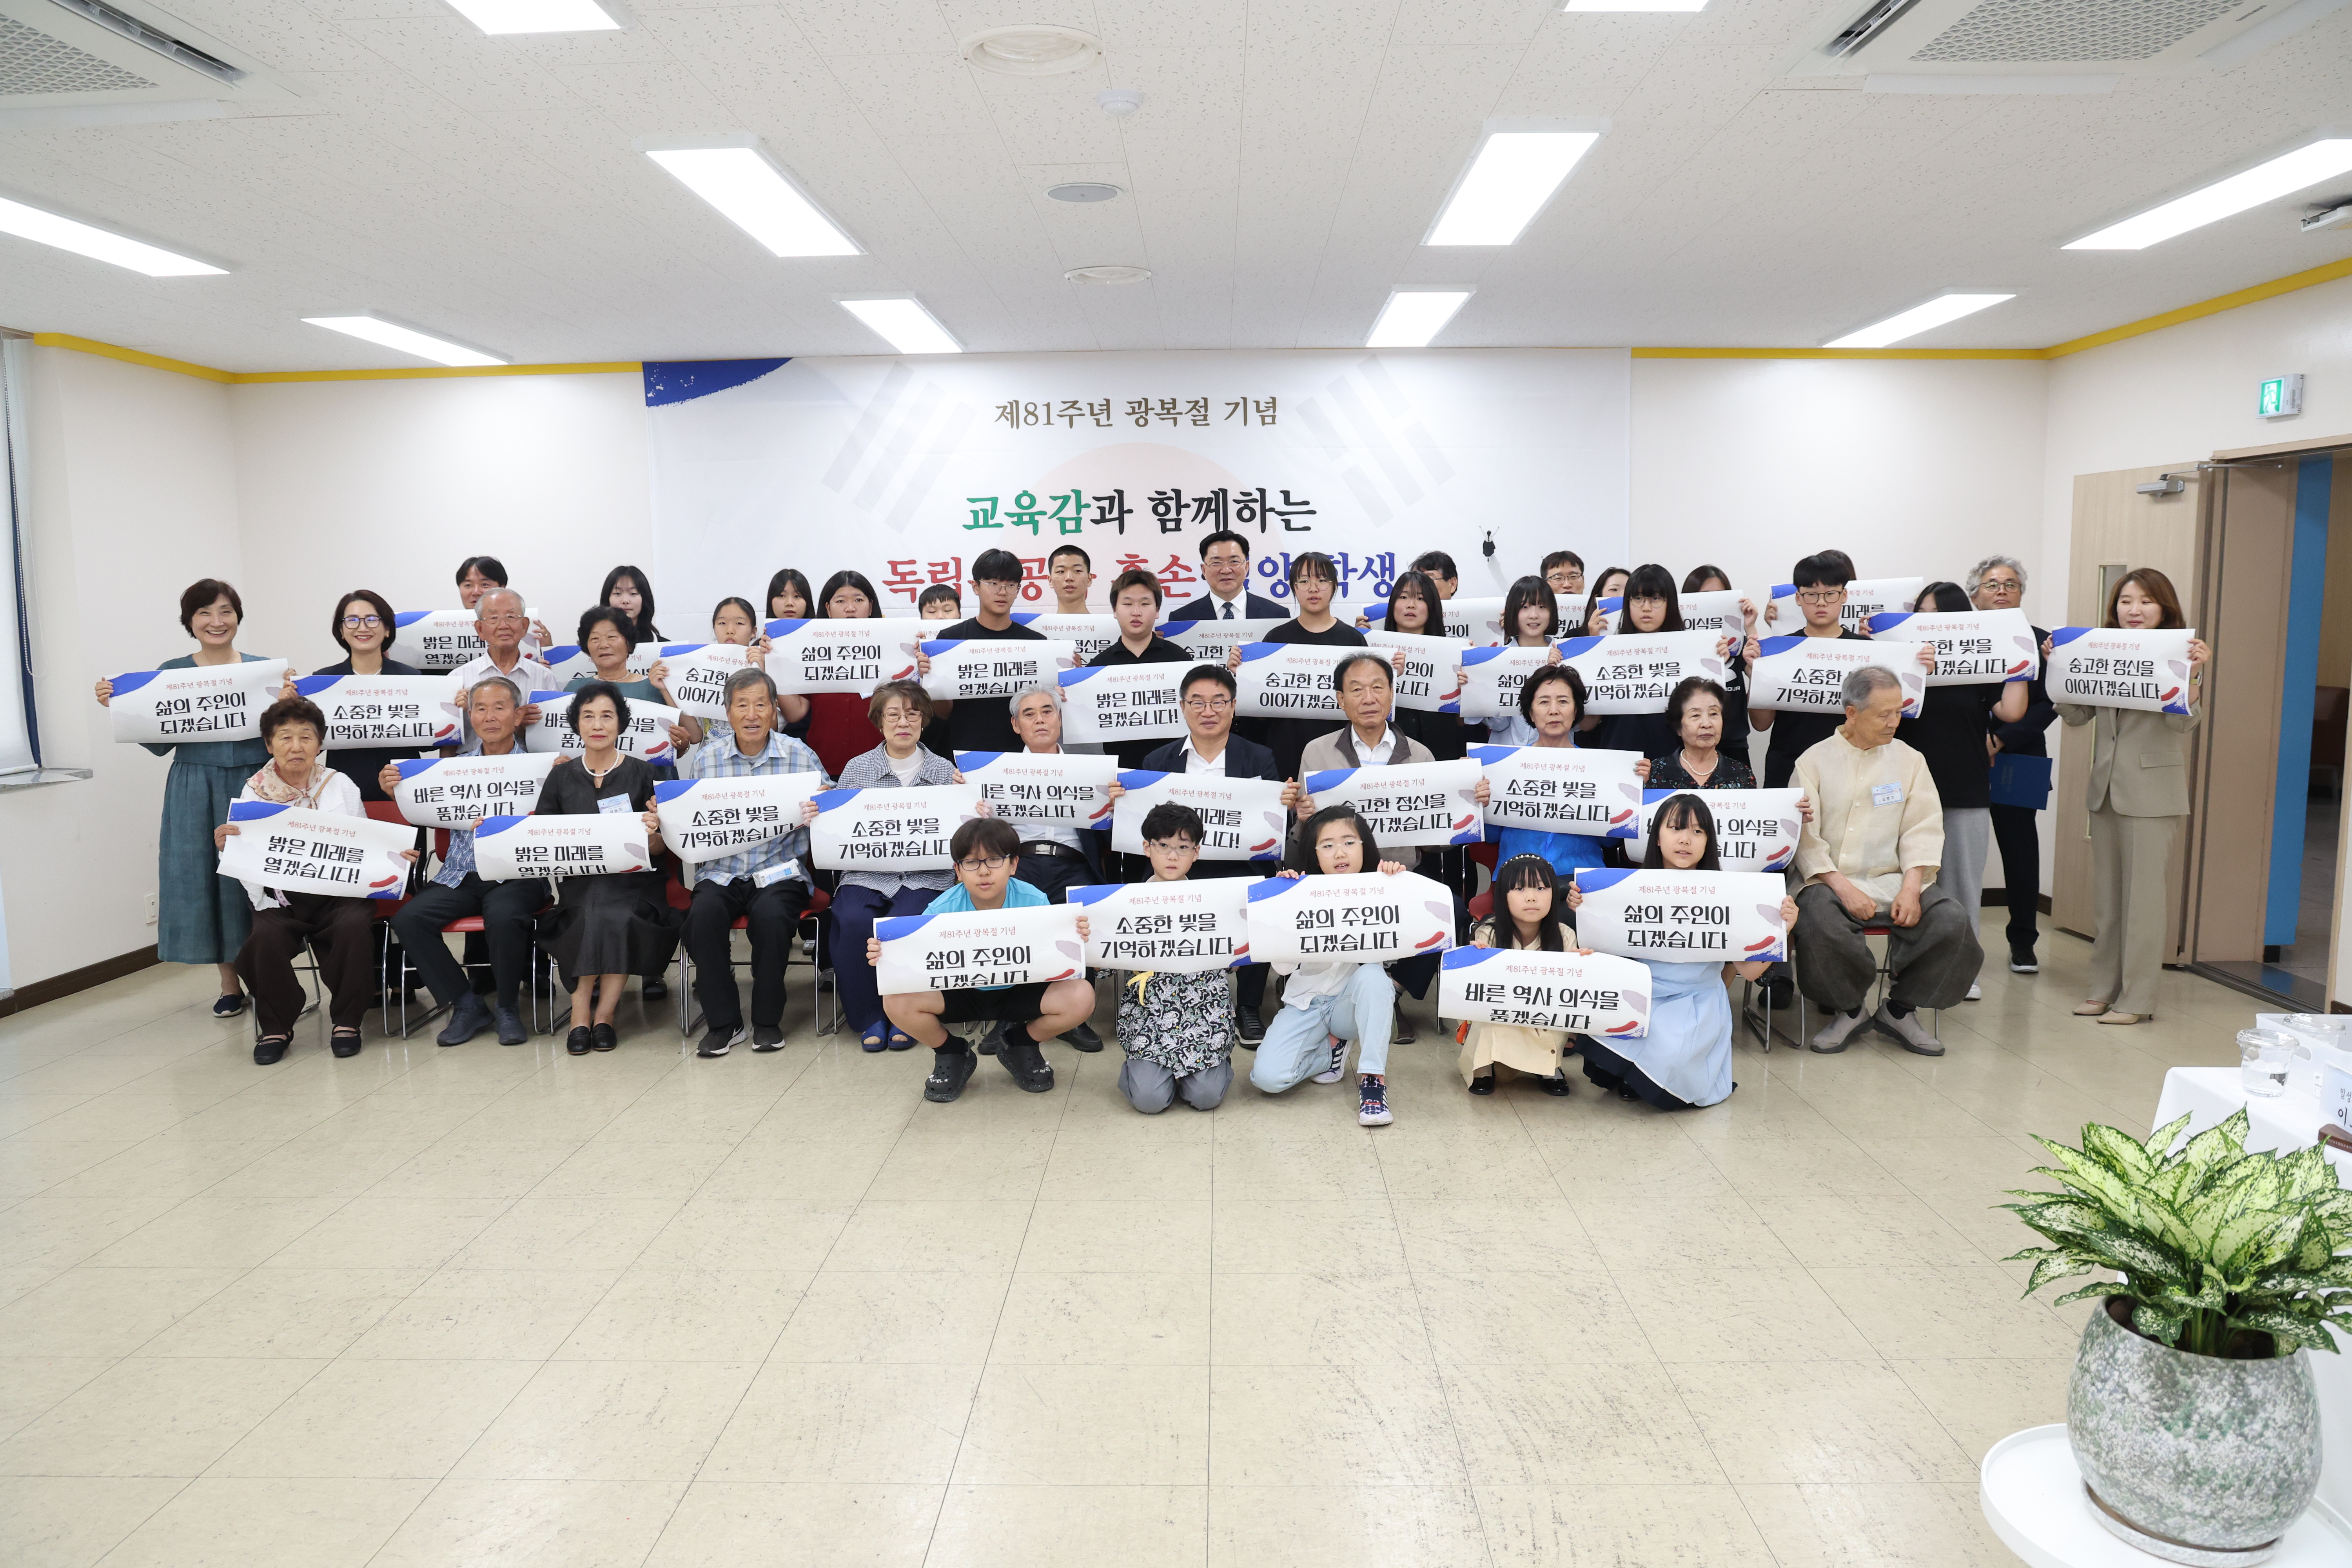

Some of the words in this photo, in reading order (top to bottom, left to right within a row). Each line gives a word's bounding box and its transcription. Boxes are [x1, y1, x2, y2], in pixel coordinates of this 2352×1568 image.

[995, 398, 1113, 430] 제81주년
[1125, 397, 1210, 427] 광복절
[1224, 396, 1277, 427] 기념
[962, 489, 1134, 536] 교육감과
[1147, 487, 1317, 536] 함께하는
[423, 636, 453, 650] 밝은
[1606, 648, 1632, 657] 제81주년
[1634, 647, 1653, 655] 광복절
[1959, 639, 1992, 654] 빛을
[707, 655, 730, 664] 제81주년
[801, 646, 831, 661] 삶의
[837, 645, 881, 660] 주인이
[1806, 652, 1832, 661] 제81주년
[804, 664, 880, 681] 되겠습니다
[958, 663, 989, 679] 밝은
[993, 661, 1038, 677] 미래를
[1596, 664, 1644, 681] 소중한
[1649, 662, 1681, 678] 빛을
[2069, 658, 2109, 675] 숭고한
[2113, 659, 2154, 677] 정신을
[166, 682, 194, 690] 제81주년
[196, 679, 217, 688] 광복절
[1265, 672, 1312, 689] 숭고한
[1791, 668, 1842, 686] 소중한
[2065, 679, 2160, 699] 이어가겠습니다
[155, 698, 191, 716] 삶의
[196, 692, 246, 711] 주인이
[1096, 692, 1127, 708] 밝은
[1131, 689, 1177, 706] 미래를
[332, 704, 383, 720] 소중한
[388, 704, 420, 719] 빛을
[1098, 708, 1178, 728] 열겠습니다!
[160, 711, 247, 734] 되겠습니다
[322, 722, 434, 740] 기억하겠습니다
[1003, 768, 1027, 776] 제81주년
[1029, 768, 1049, 777] 광복절
[1520, 762, 1547, 771] 제81주년
[1572, 764, 1585, 773] 기념
[414, 786, 445, 803] 바른
[450, 784, 482, 800] 역사
[487, 780, 535, 797] 의식을
[1010, 784, 1042, 800] 역사
[1047, 786, 1094, 800] 의식을
[1168, 788, 1194, 797] 제81주년
[1196, 790, 1216, 799] 광복절
[1360, 781, 1387, 790] 제81주년
[1389, 779, 1409, 788] 광복절
[1506, 779, 1557, 797] 소중한
[1563, 781, 1597, 799] 빛을
[701, 792, 728, 801] 제81주년
[730, 790, 750, 799] 광복절
[1396, 793, 1446, 811] 정신을
[864, 803, 889, 811] 제81주년
[892, 802, 911, 810] 광복절
[996, 804, 1076, 818] 품겠습니다
[1492, 800, 1610, 822] 기억하겠습니다
[691, 808, 741, 827] 소중한
[746, 806, 779, 823] 빛을
[287, 821, 316, 831] 제81주년
[318, 826, 339, 835] 광복절
[341, 829, 356, 838] 기념
[851, 819, 902, 837] 소중한
[907, 818, 940, 835] 빛을
[1728, 819, 1778, 837] 의식을
[268, 835, 305, 856] 밝은
[310, 842, 364, 864] 미래를
[515, 847, 549, 862] 밝은
[554, 846, 604, 861] 미래를
[263, 857, 362, 884] 열겠습니다!
[518, 865, 608, 880] 열겠습니다!
[1309, 889, 1340, 898] 제81주년
[1343, 887, 1366, 897] 광복절
[1369, 886, 1384, 895] 기념
[1638, 885, 1670, 894] 제81주년
[1673, 886, 1697, 894] 광복절
[1700, 886, 1715, 895] 기념
[1129, 896, 1159, 906] 제81주년
[1161, 895, 1184, 904] 광복절
[1187, 893, 1201, 902] 기념
[1115, 915, 1173, 934] 소중한
[1179, 913, 1217, 932] 빛을
[1296, 909, 1334, 929] 삶의
[1341, 905, 1399, 926] 주인이
[1624, 905, 1663, 924] 삶의
[1670, 906, 1730, 925] 주인이
[939, 929, 971, 939] 제81주년
[973, 927, 997, 937] 광복절
[1000, 926, 1015, 935] 기념
[1628, 930, 1728, 949] 되겠습니다
[1100, 936, 1234, 958] 기억하겠습니다
[1300, 931, 1399, 953] 되겠습니다
[926, 950, 965, 970] 삶의
[972, 946, 1031, 967] 주인이
[929, 970, 1029, 989] 되겠습니다
[1505, 964, 1537, 975] 제81주년
[1540, 966, 1564, 976] 광복절
[1566, 968, 1582, 977] 기념
[1465, 983, 1506, 1003] 바른
[1513, 985, 1553, 1006] 역사
[1558, 988, 1619, 1011] 의식을
[1490, 1009, 1590, 1030] 품겠습니다
